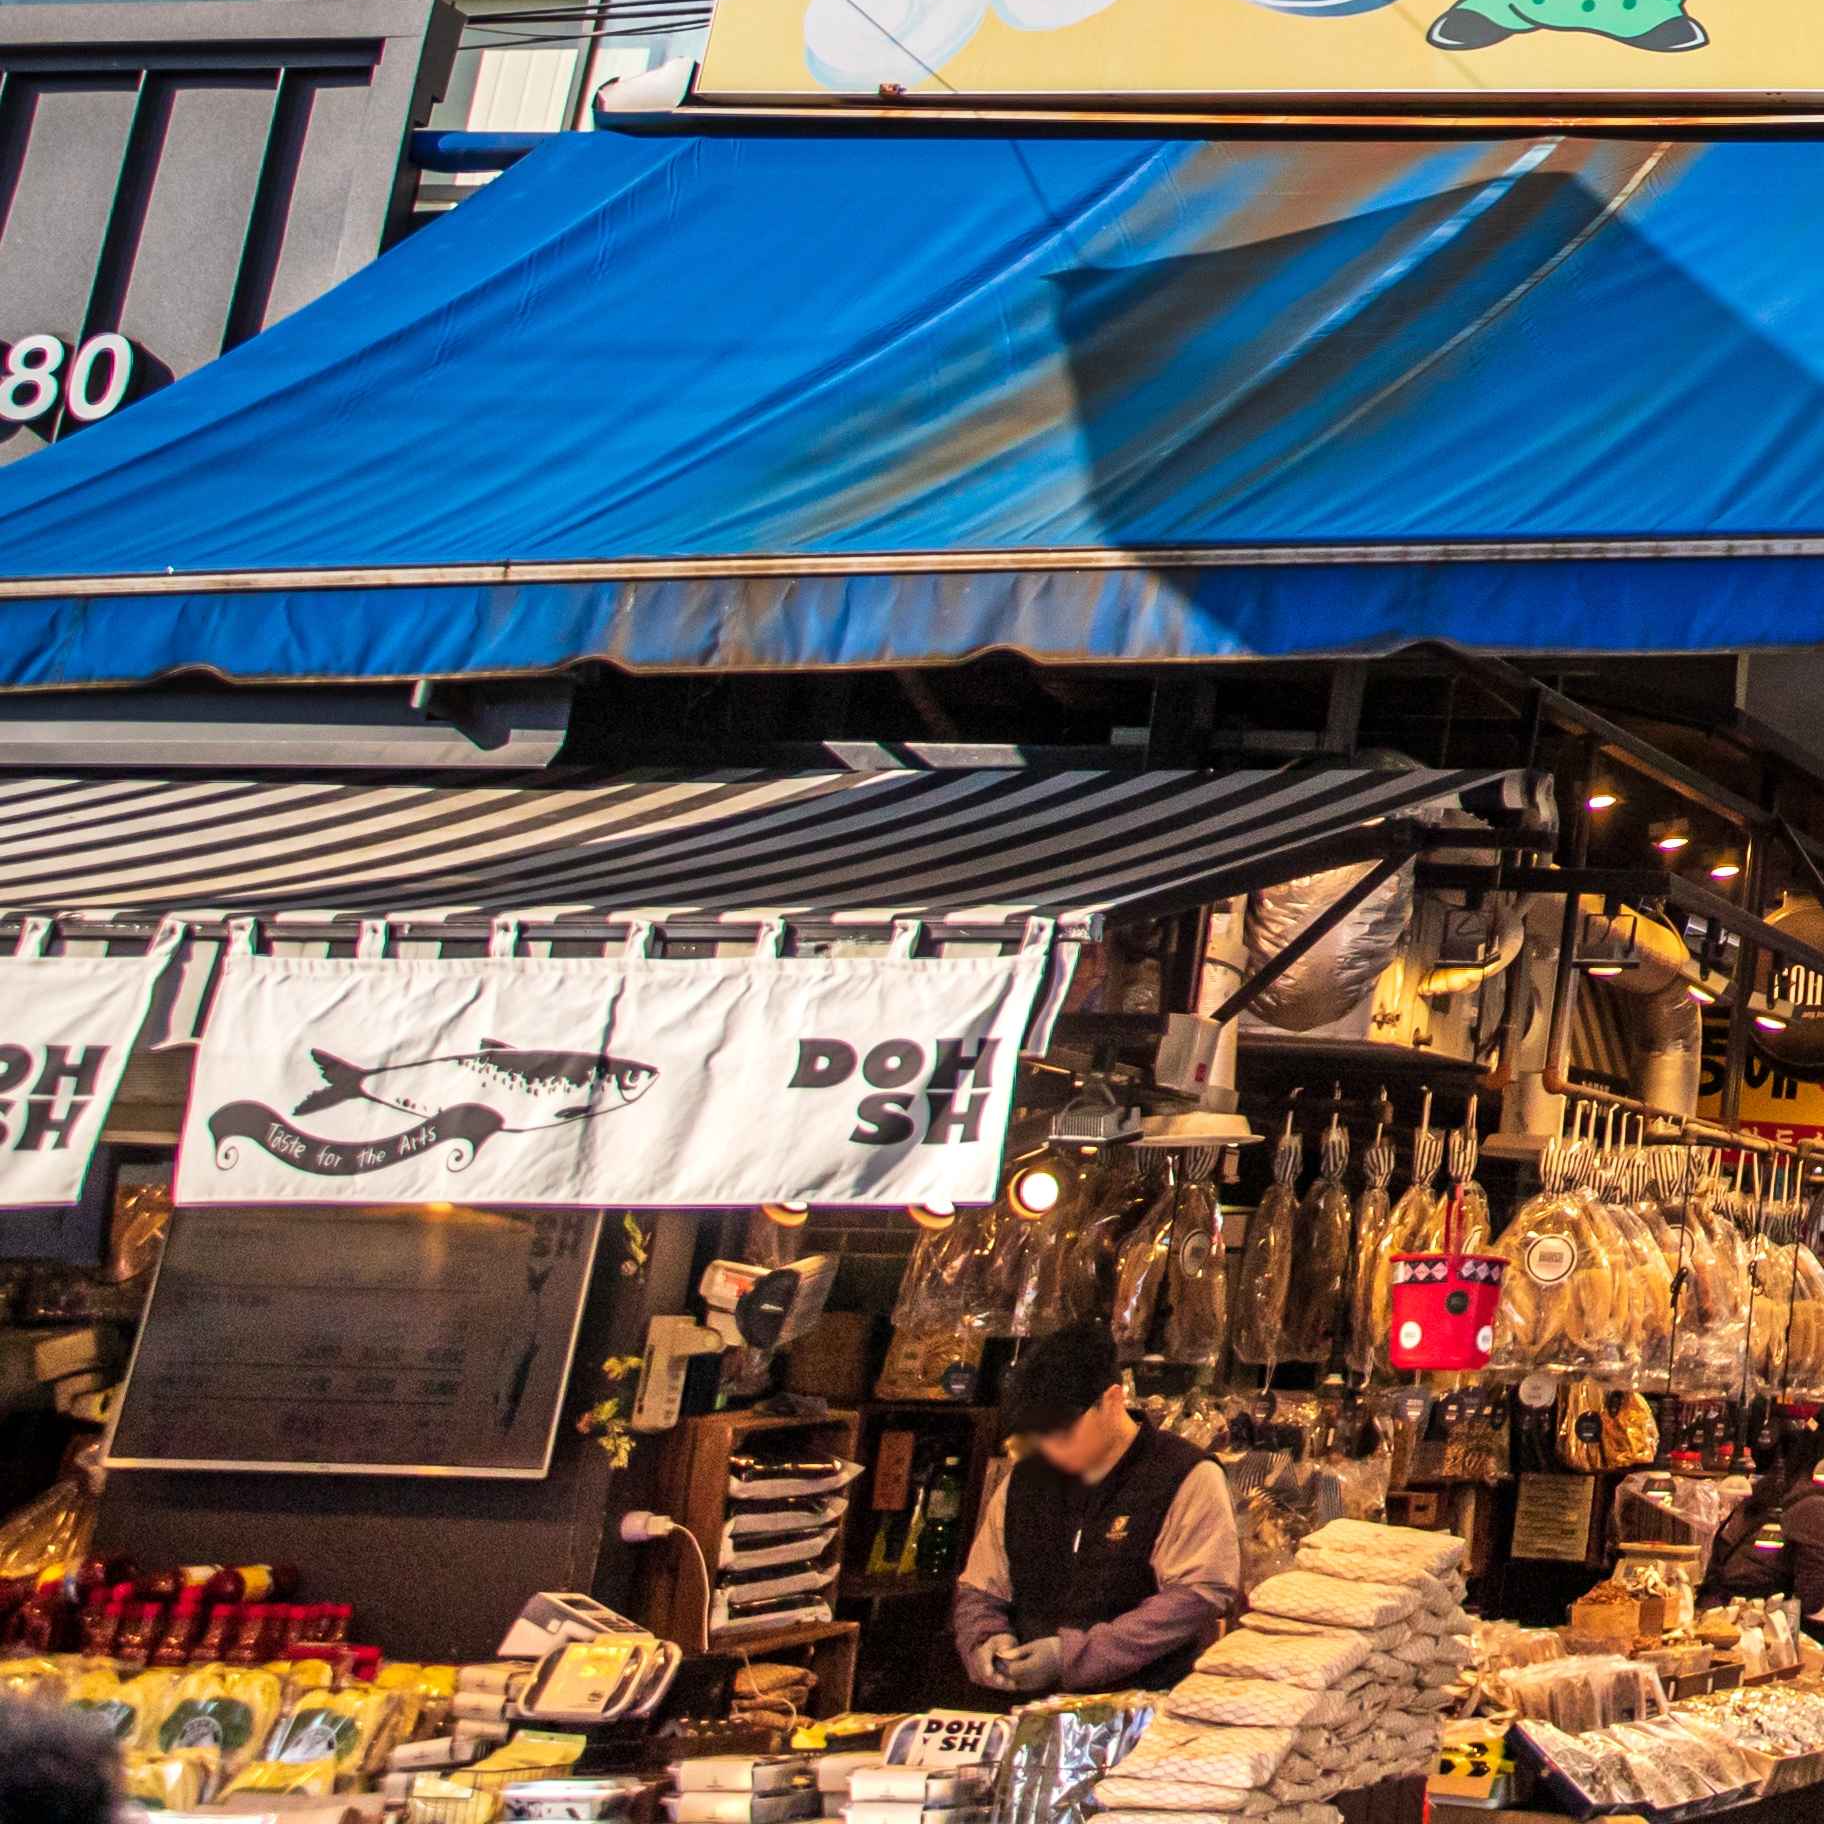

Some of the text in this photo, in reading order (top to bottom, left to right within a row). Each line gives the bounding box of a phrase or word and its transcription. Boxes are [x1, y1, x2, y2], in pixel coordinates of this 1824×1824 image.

[787, 1037, 1003, 1090] DOH
[0, 1098, 94, 1151] H
[848, 1091, 992, 1145] SH
[265, 1122, 437, 1168] Taste for the Arts
[924, 1718, 988, 1736] DOH
[938, 1736, 981, 1753] SH
